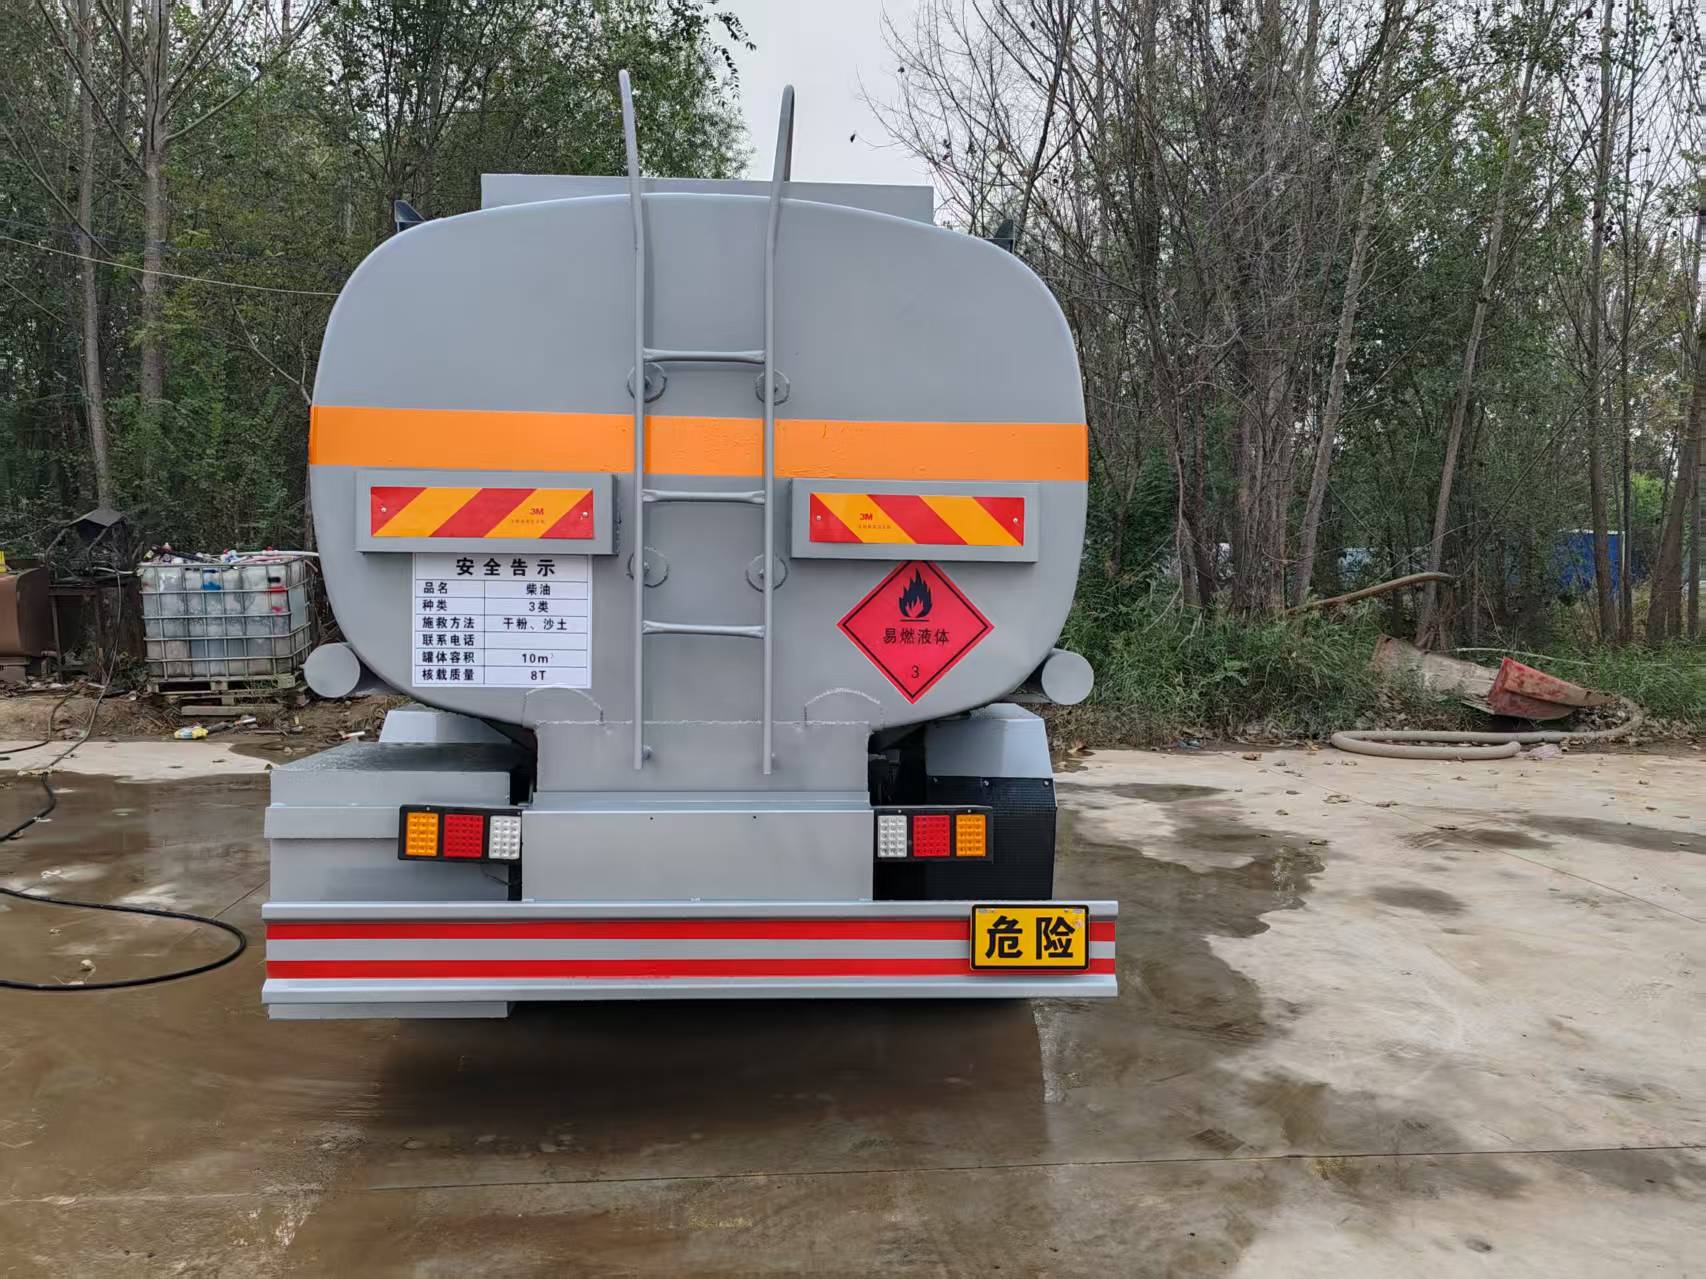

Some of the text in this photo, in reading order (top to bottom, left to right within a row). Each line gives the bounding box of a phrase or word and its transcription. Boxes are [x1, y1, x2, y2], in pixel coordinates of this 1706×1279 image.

[859, 513, 873, 521] 3M
[456, 557, 555, 577] 安全告示
[423, 581, 448, 595] 品名
[526, 583, 551, 596] 柴油
[422, 599, 447, 612] 种类
[528, 601, 549, 613] 3类
[422, 616, 475, 629] 施救方法
[503, 617, 568, 631] 干粉、沙土
[422, 633, 475, 647] 联系电话
[883, 627, 950, 645] 易燃液体
[422, 651, 475, 664] 罐体容积
[422, 668, 475, 681] 核载质量
[530, 670, 547, 681] 8T
[911, 665, 920, 679] 3
[985, 915, 1075, 960] 危险
